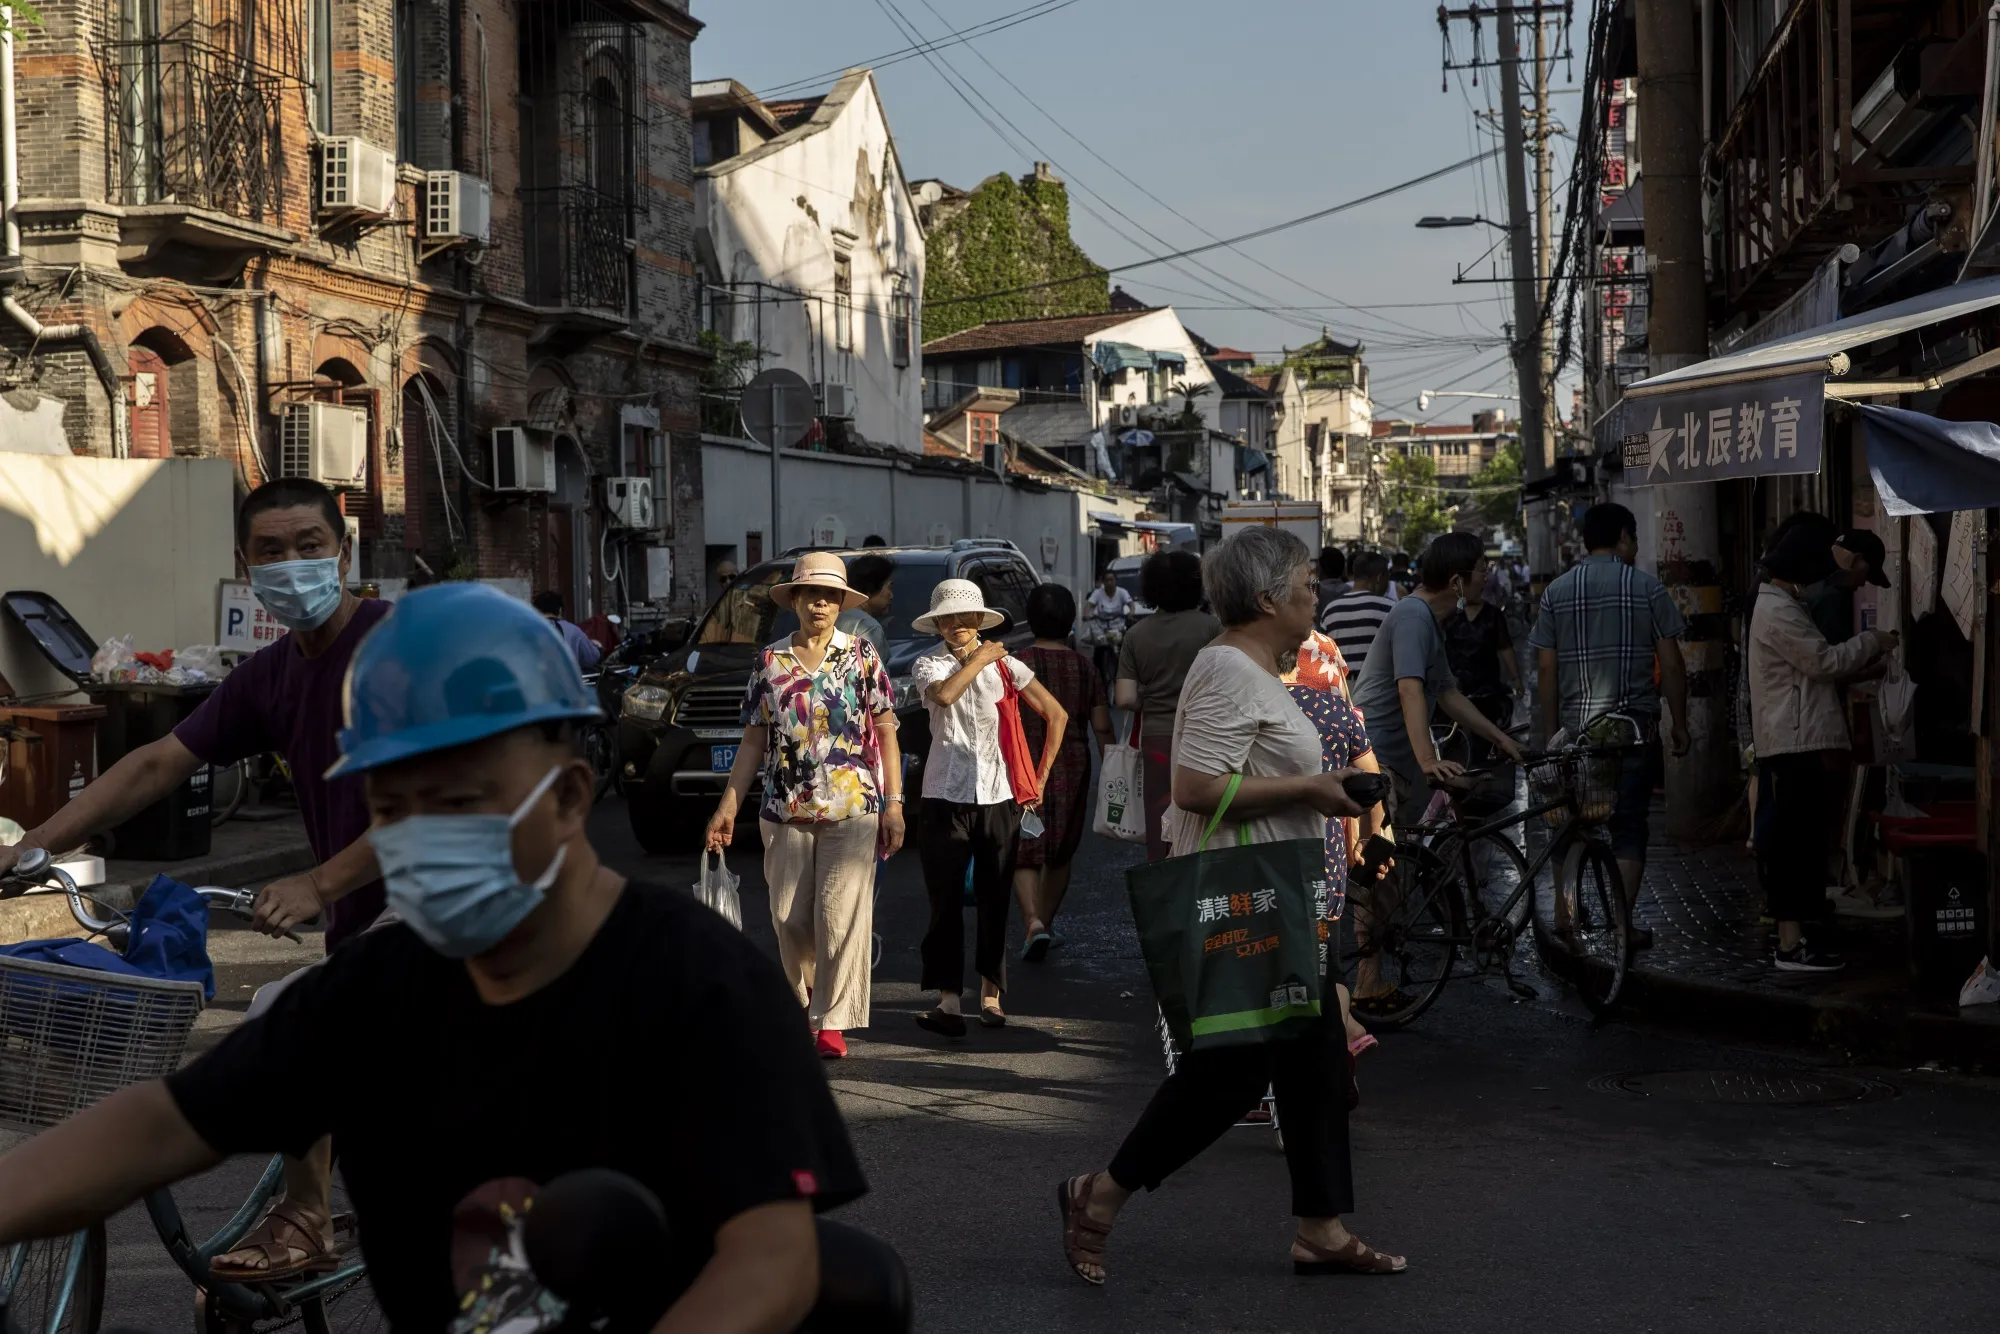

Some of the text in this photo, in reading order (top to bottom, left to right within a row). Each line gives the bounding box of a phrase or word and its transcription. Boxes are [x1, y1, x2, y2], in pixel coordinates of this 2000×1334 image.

[1677, 397, 1802, 469] 北辰教育
[228, 607, 244, 636] P
[1196, 888, 1278, 923] 清美鲜家
[1312, 880, 1329, 963] 清美鲜家
